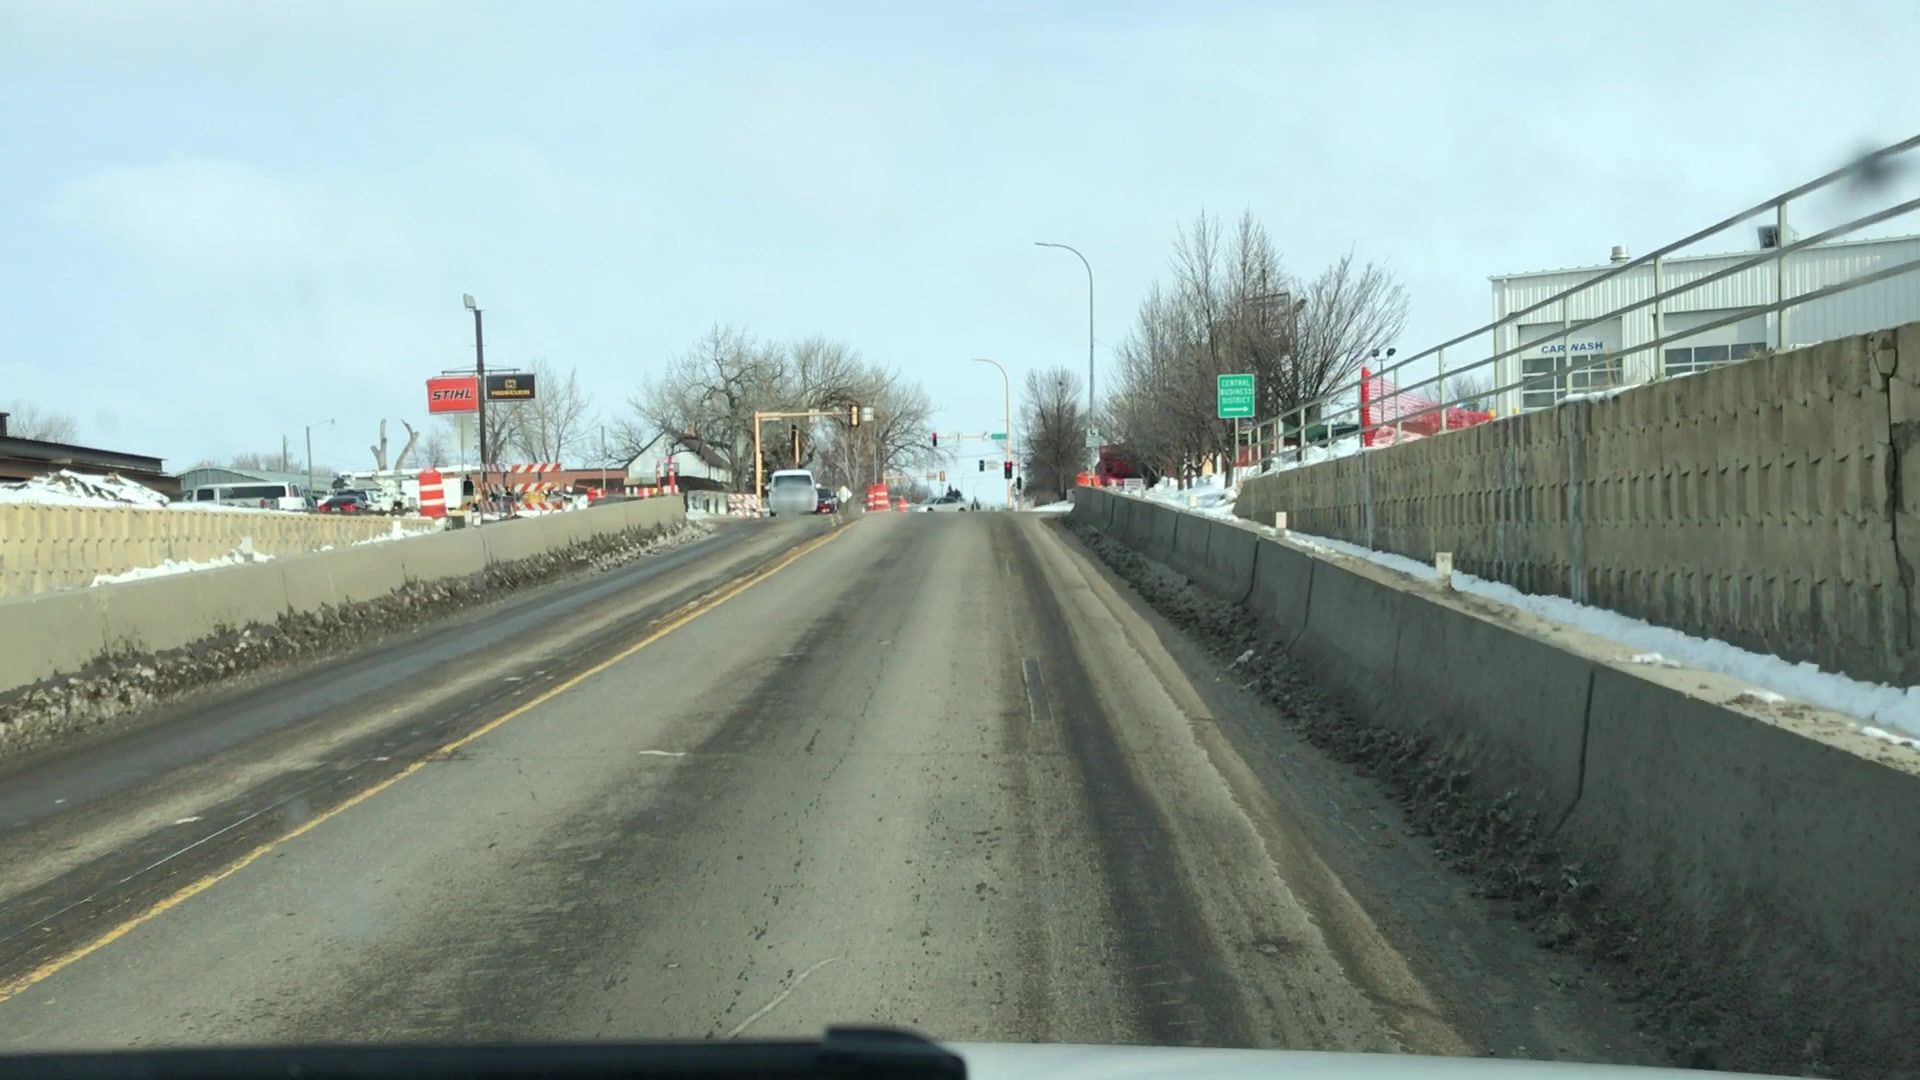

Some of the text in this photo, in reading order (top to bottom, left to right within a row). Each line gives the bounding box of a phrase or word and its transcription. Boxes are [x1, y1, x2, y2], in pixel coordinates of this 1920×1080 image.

[1541, 341, 1603, 353] CAR WASH
[1221, 379, 1251, 387] CENTRAL
[432, 389, 472, 400] STIHL
[1220, 388, 1252, 396] BUSINESS
[1222, 396, 1250, 404] DISTRICT
